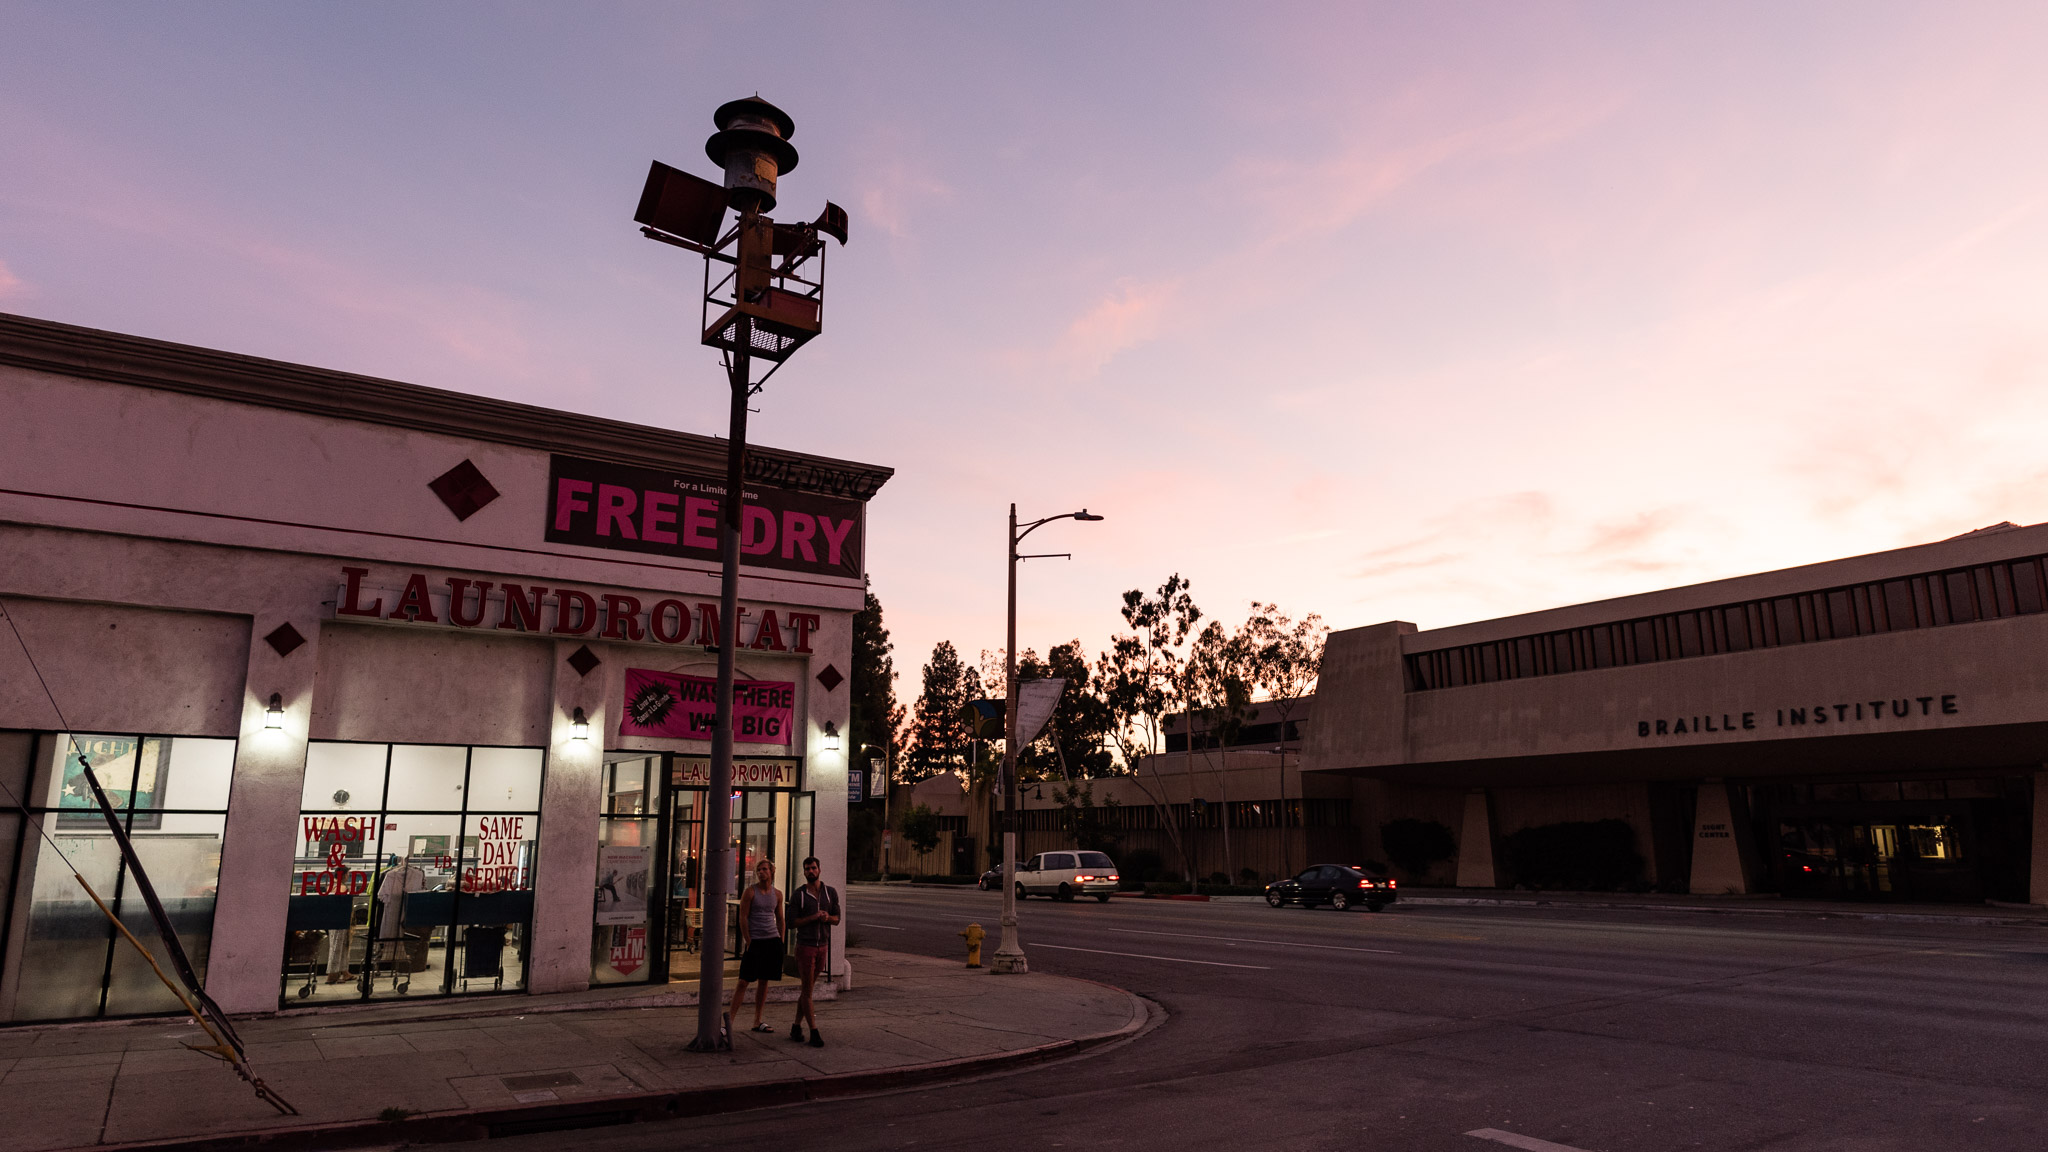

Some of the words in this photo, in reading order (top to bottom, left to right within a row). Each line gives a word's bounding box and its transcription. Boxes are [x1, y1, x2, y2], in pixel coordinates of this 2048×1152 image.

[673, 479, 690, 490] For
[700, 483, 727, 496] Limite
[742, 489, 759, 500] ime
[554, 478, 718, 549] FREE
[741, 505, 855, 566] DRY
[336, 566, 821, 654] LAUNDROMAT
[743, 687, 793, 709] HERE
[742, 715, 781, 737] BIG
[1638, 712, 1756, 738] BRAILLE
[1777, 694, 1959, 726] INSTITUTE
[303, 816, 377, 842] WASH
[479, 816, 524, 840] SAME
[327, 842, 347, 868] &
[482, 842, 517, 865] DAY
[300, 870, 367, 896] FOLD
[464, 867, 529, 892] SERVICE
[612, 938, 644, 959] ATM
